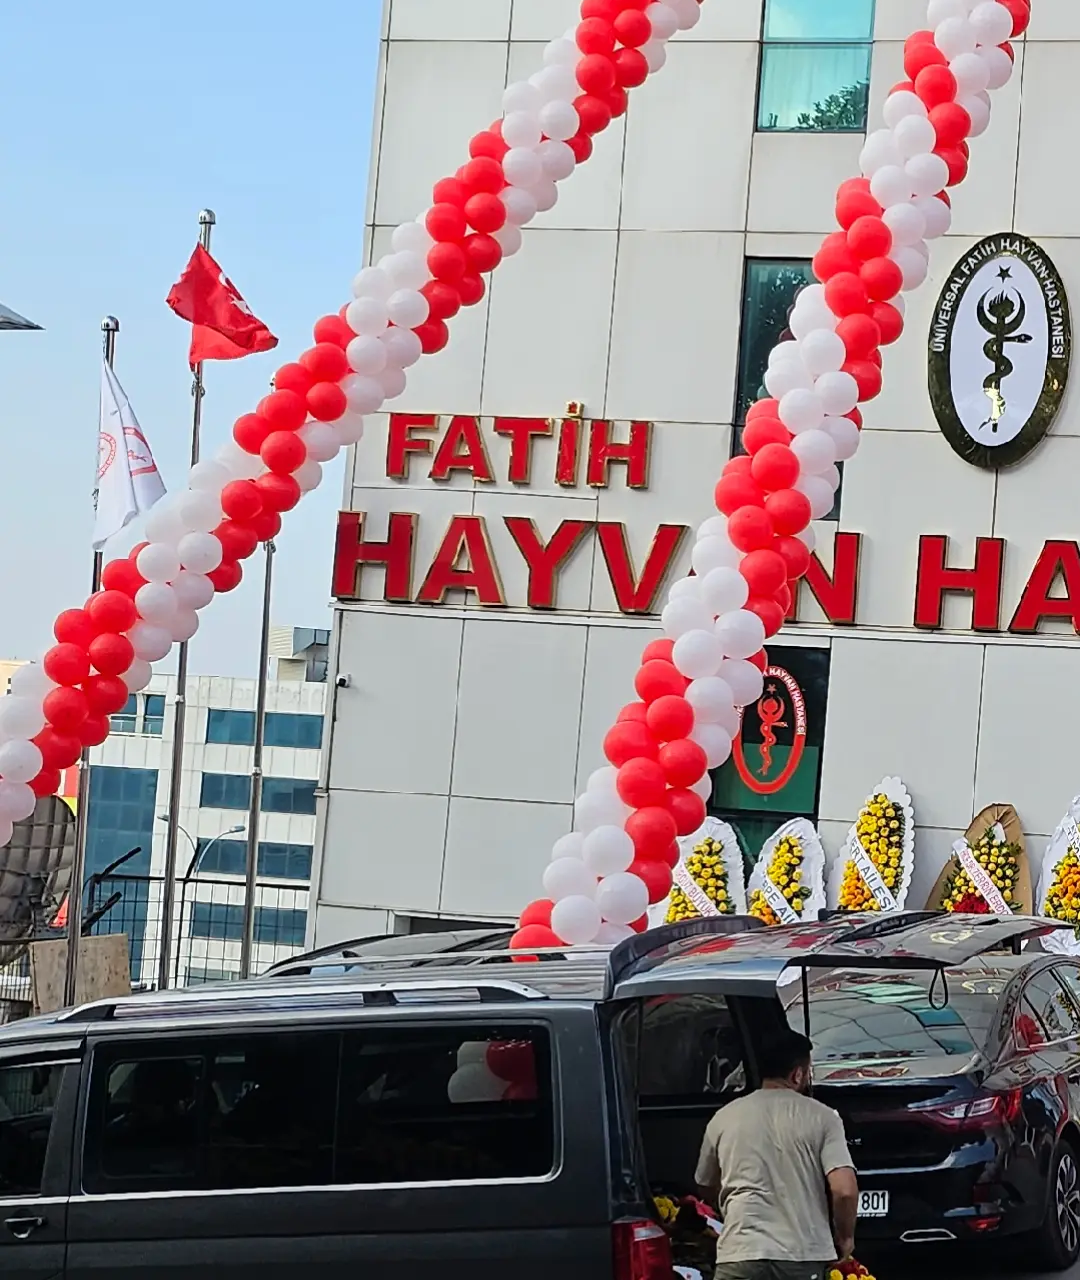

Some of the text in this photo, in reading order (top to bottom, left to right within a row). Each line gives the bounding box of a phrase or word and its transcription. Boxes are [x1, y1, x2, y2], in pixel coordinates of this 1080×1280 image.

[932, 277, 966, 352] UNIVERSAL
[961, 241, 997, 276] FATİH
[1000, 238, 1049, 279] HAYVAN
[386, 400, 654, 488] FATİH
[331, 510, 863, 625] HAYVN
[861, 1192, 886, 1210] 801
